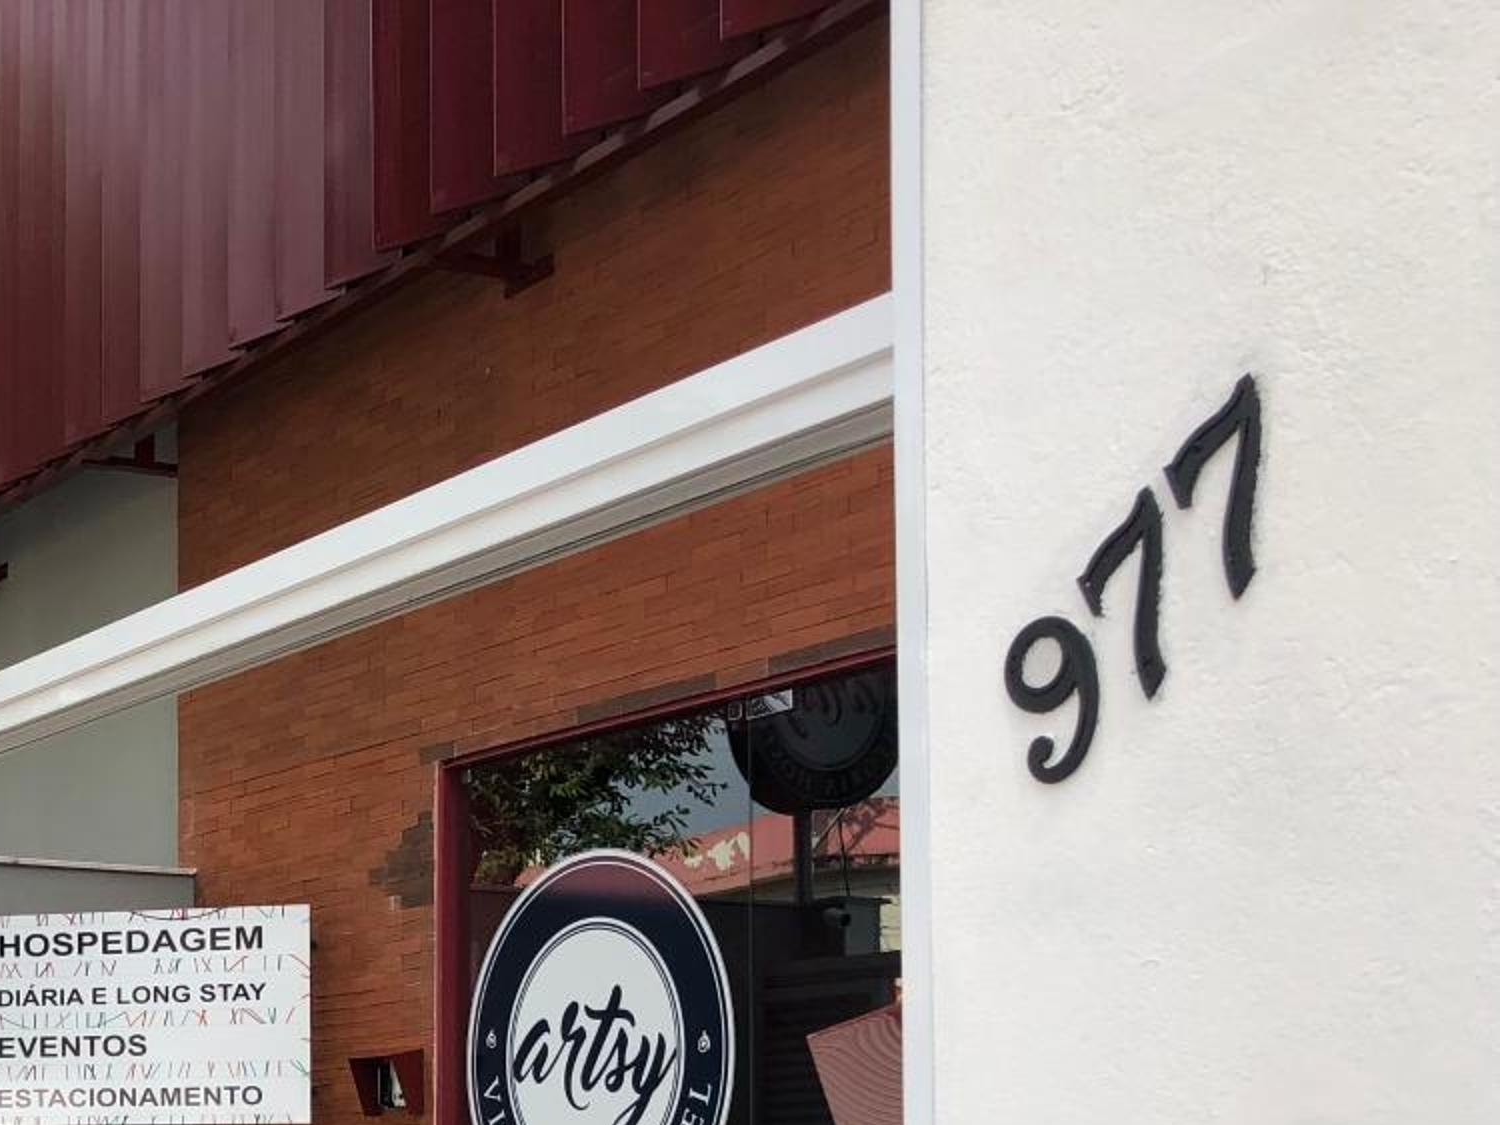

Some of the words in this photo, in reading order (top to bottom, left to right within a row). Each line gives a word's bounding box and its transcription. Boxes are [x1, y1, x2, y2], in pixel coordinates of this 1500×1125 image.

[1003, 371, 1263, 785] 977
[91, 987, 108, 1006] E
[116, 985, 192, 1005] LONG
[199, 982, 267, 1002] STAY
